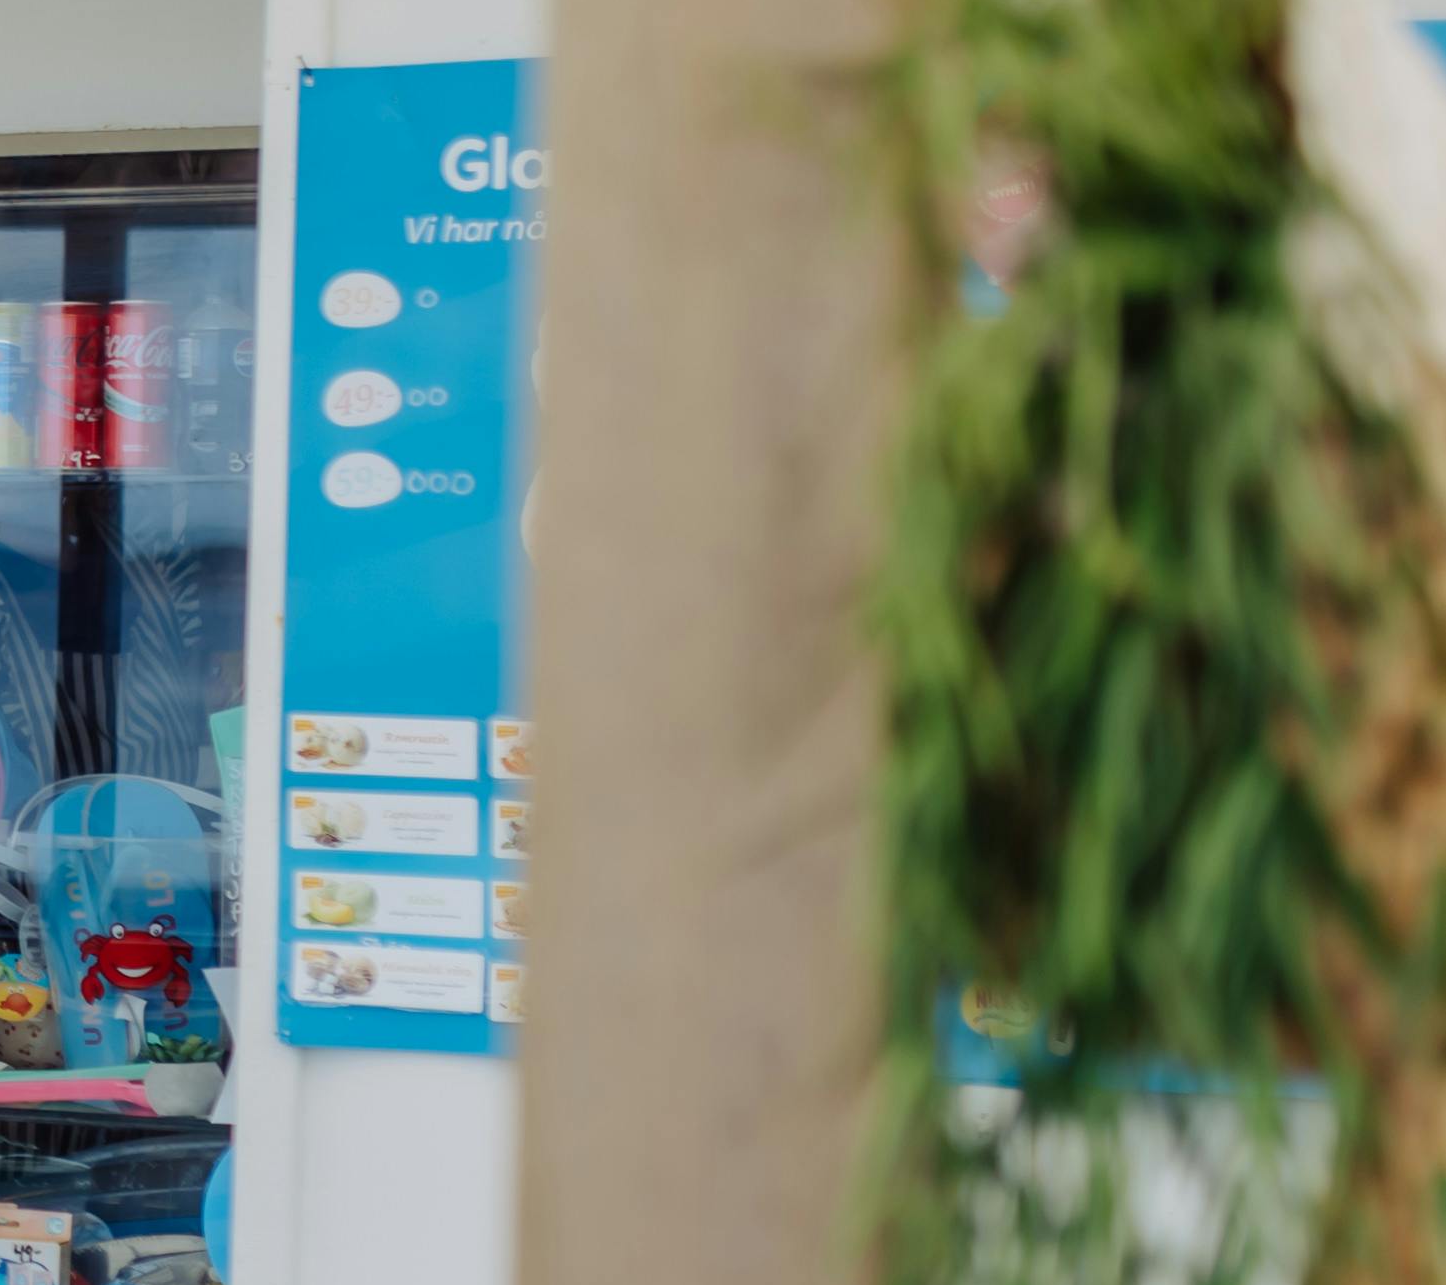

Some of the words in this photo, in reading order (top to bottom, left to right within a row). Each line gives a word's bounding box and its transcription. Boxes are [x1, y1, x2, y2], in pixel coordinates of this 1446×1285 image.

[440, 134, 554, 192] Gla
[404, 216, 437, 244] Vi
[440, 216, 499, 243] har
